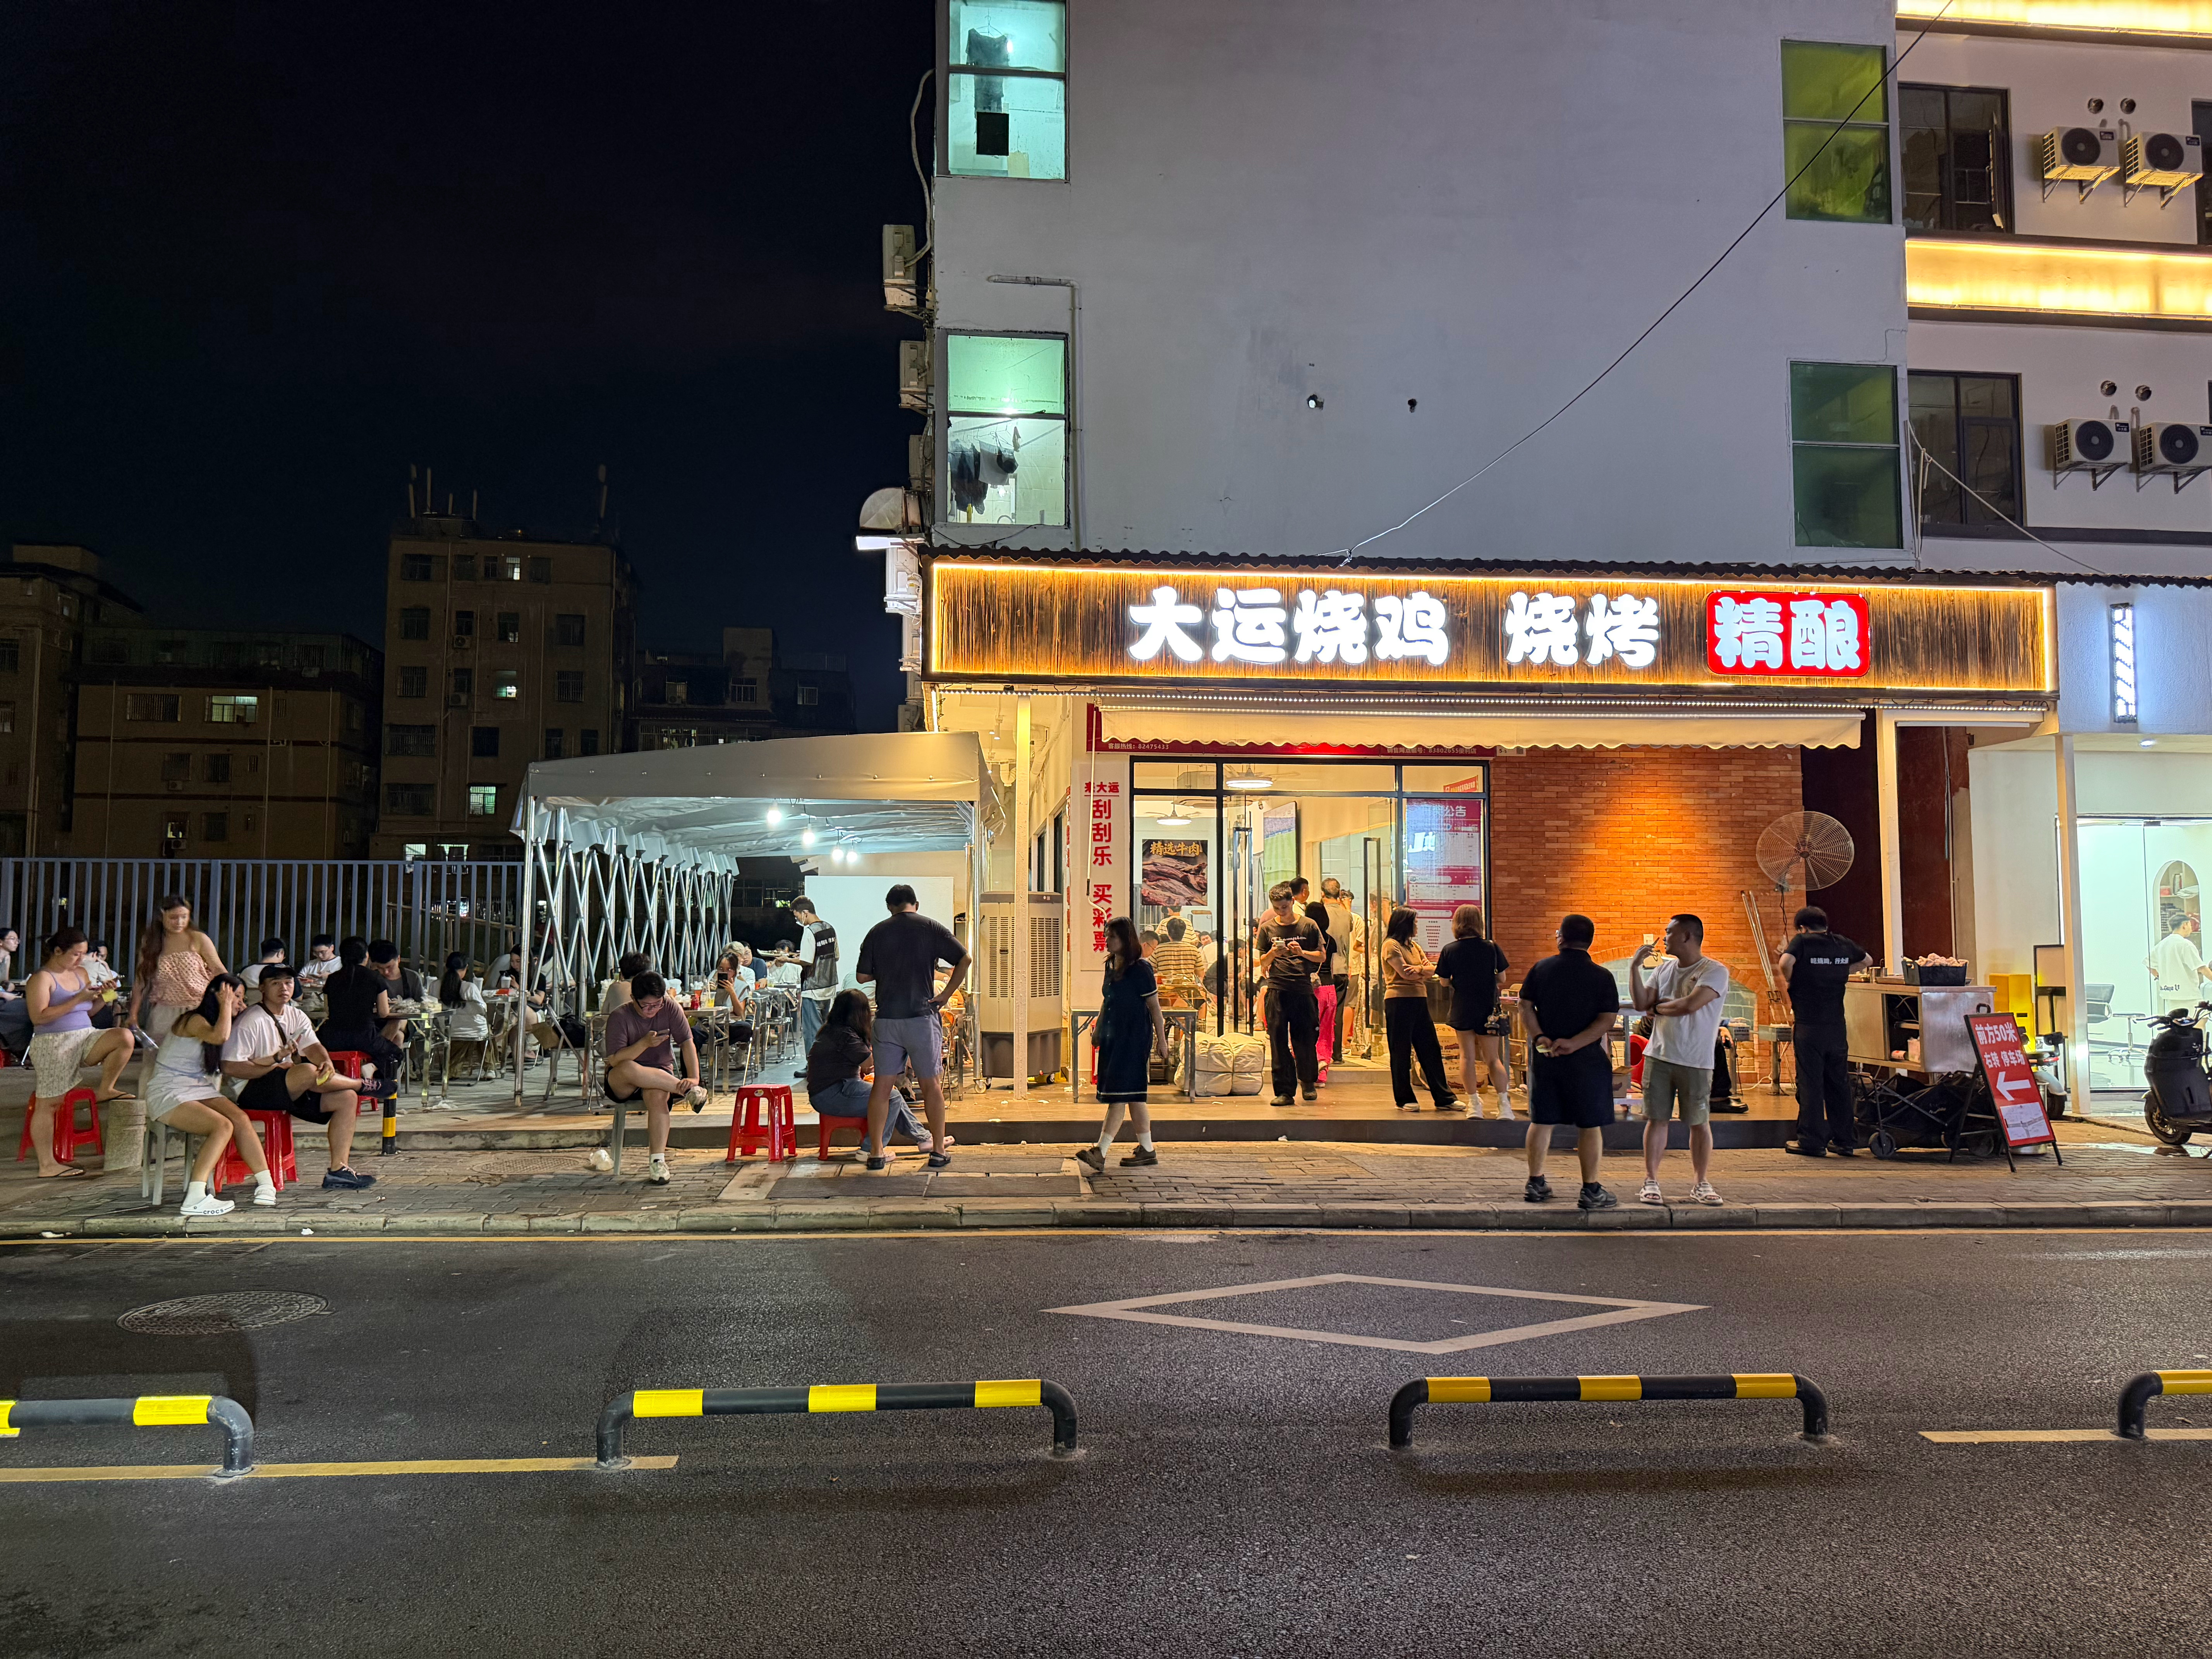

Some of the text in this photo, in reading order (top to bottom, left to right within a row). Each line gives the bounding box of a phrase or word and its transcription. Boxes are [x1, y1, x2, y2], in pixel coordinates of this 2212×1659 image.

[1128, 586, 1860, 670] 大运烧鸡 烧烤 精酿
[1092, 799, 1112, 866] 刮刮乐
[1150, 841, 1200, 856] 精选牛肉
[1975, 1022, 2017, 1044] 前方50米
[1984, 1050, 2025, 1068] 右转 停车场
